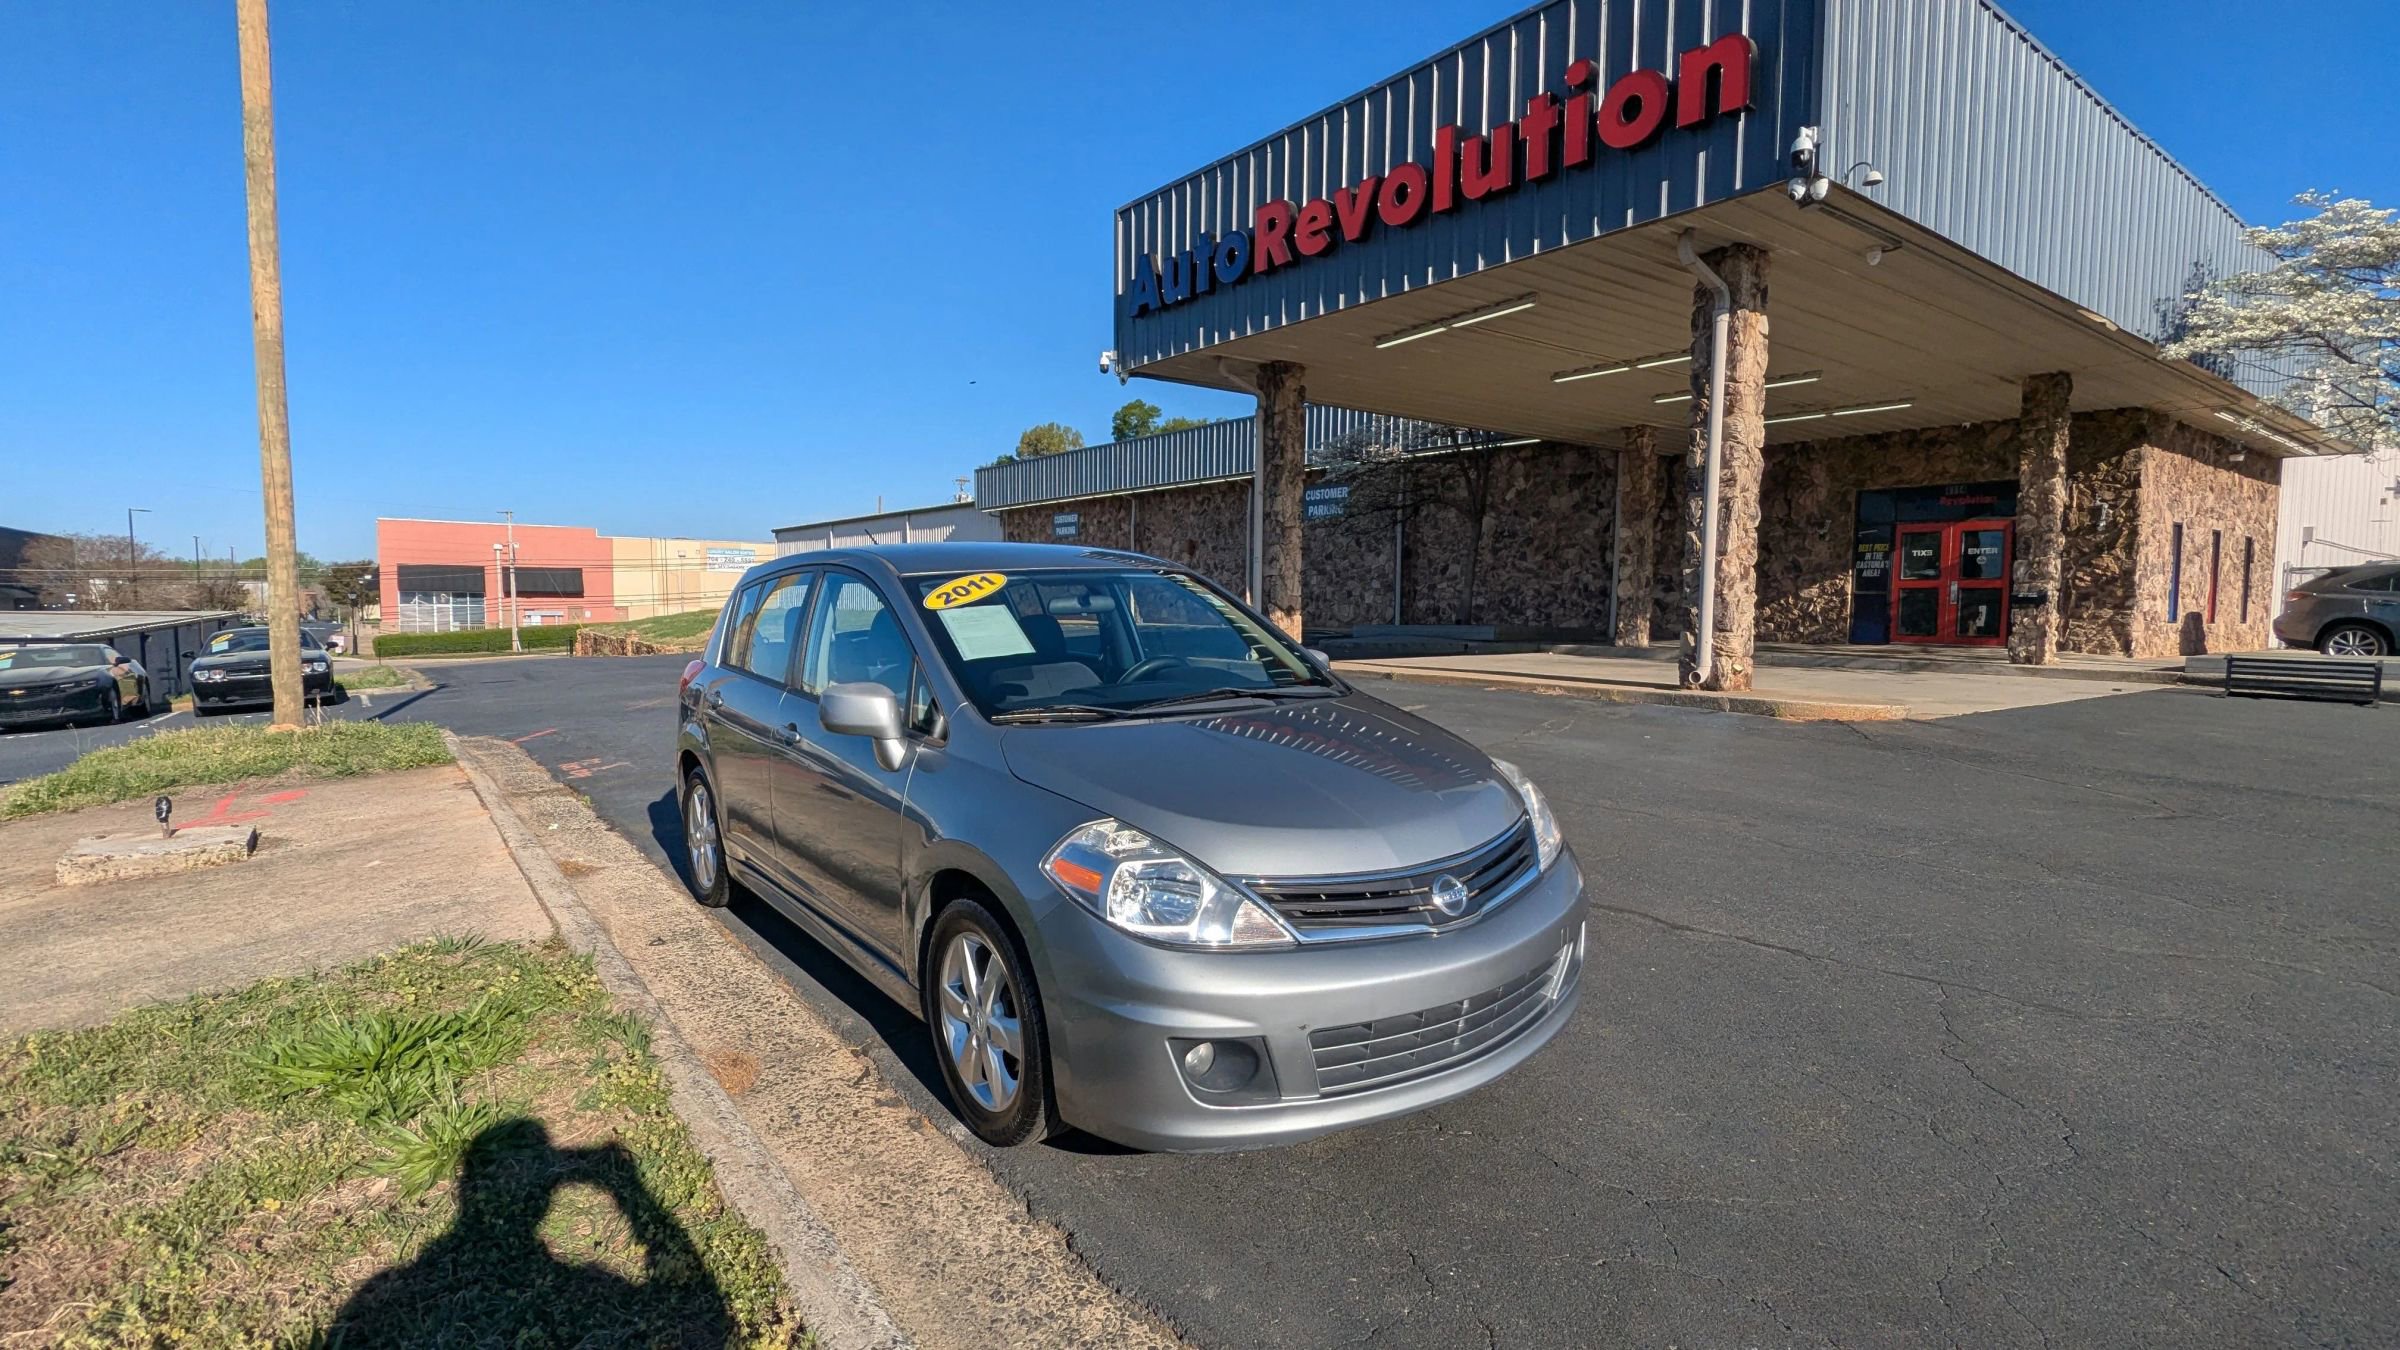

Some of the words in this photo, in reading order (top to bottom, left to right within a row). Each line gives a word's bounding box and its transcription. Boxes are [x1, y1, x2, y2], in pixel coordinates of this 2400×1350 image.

[1129, 33, 1757, 318] AutoRevolution
[1305, 487, 1348, 500] CUSTOMER
[1968, 547, 1998, 555] ENTER
[936, 576, 997, 605] 2011
